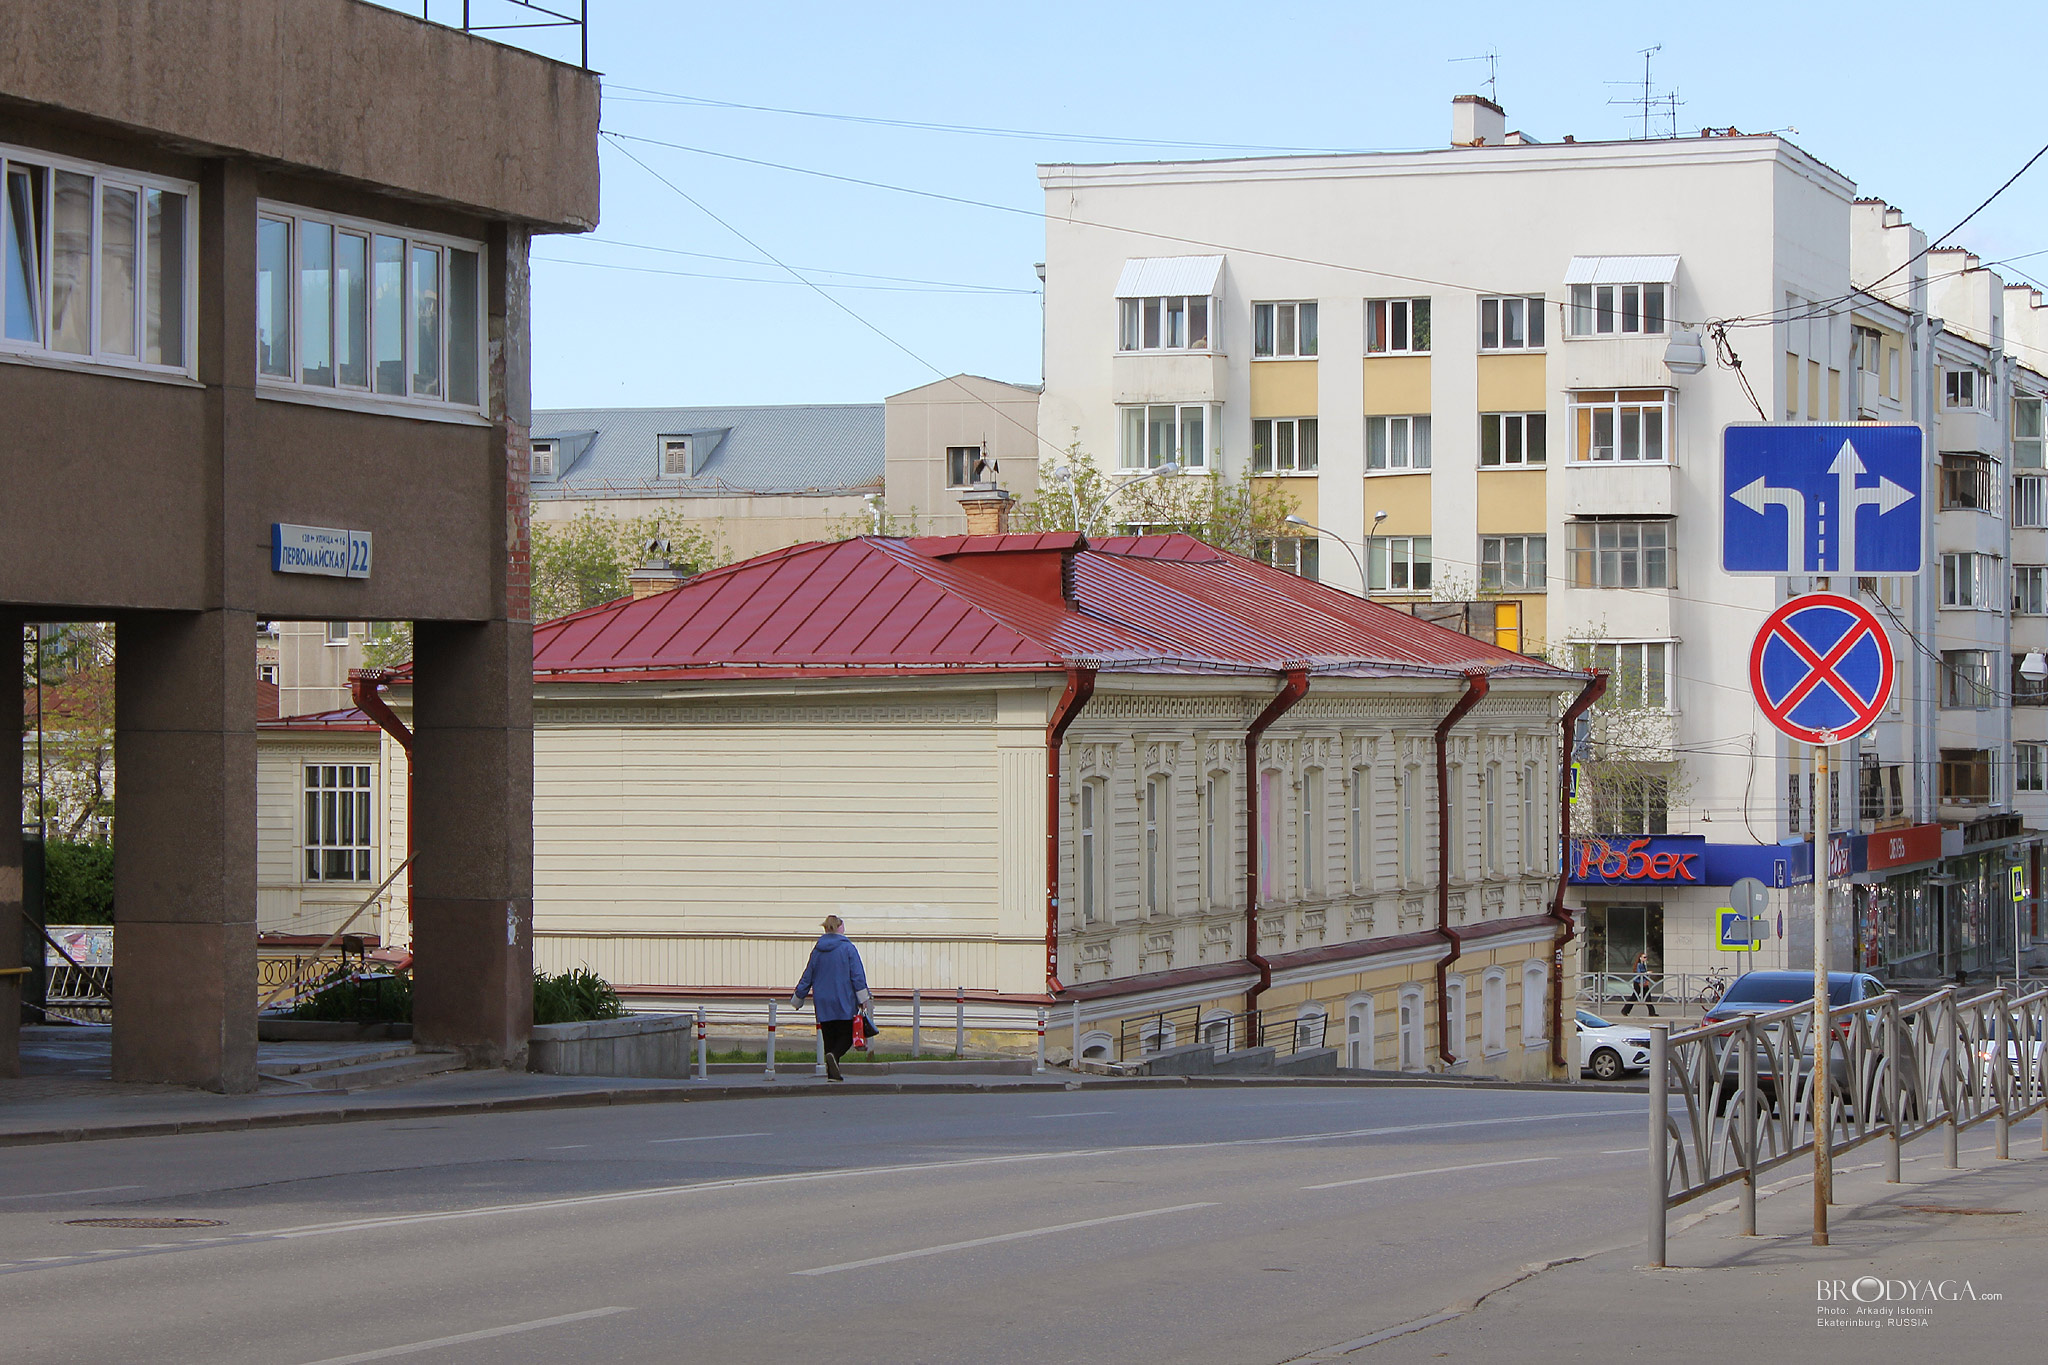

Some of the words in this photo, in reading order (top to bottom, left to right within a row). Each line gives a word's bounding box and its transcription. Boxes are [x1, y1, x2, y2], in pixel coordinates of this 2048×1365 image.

[315, 535, 334, 545] УЛИЦА
[282, 546, 345, 569] ПЕРВОМАЙСКАЯ
[351, 540, 368, 571] 22
[1578, 837, 1698, 880] Робек
